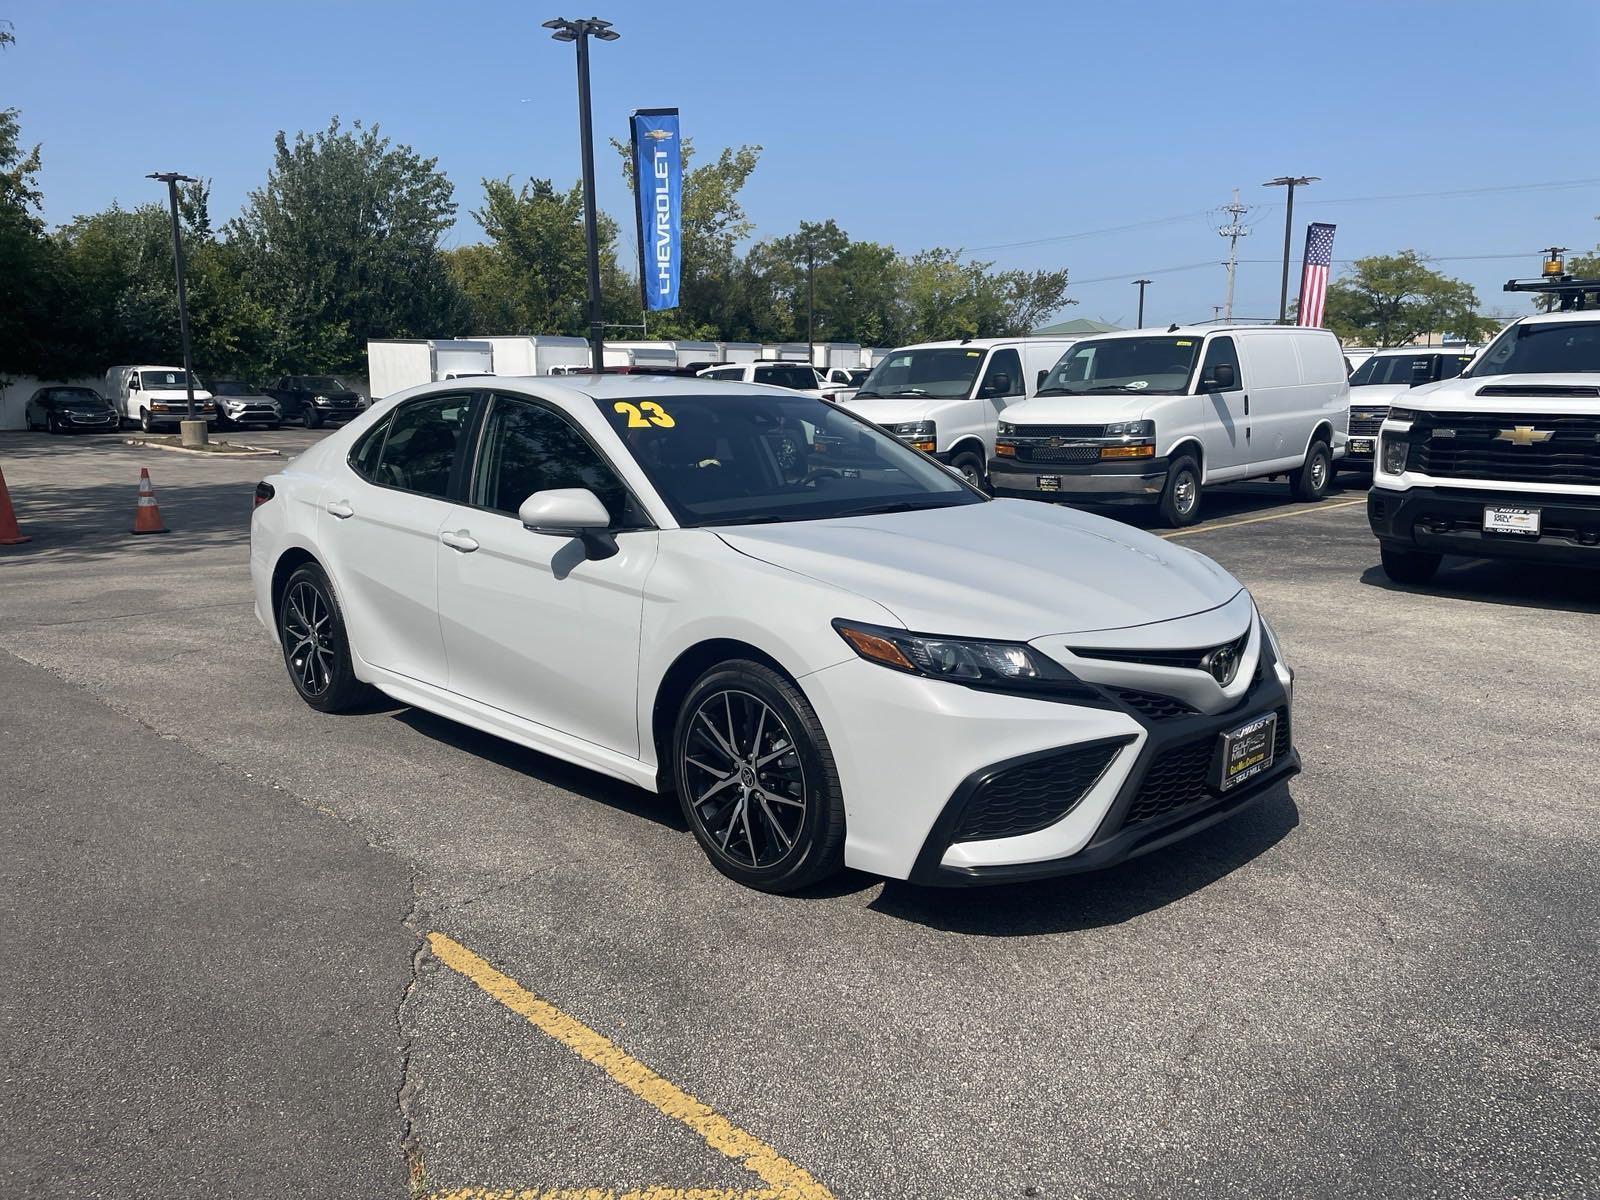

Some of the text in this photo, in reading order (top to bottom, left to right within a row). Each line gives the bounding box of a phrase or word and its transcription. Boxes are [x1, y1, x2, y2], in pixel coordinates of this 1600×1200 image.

[654, 146, 671, 294] CHEVROLET
[613, 401, 675, 428] 23
[1232, 737, 1251, 753] GOLF
[1232, 747, 1247, 762] MILL
[1236, 771, 1250, 784] GOLF
[1249, 765, 1261, 777] MILL
